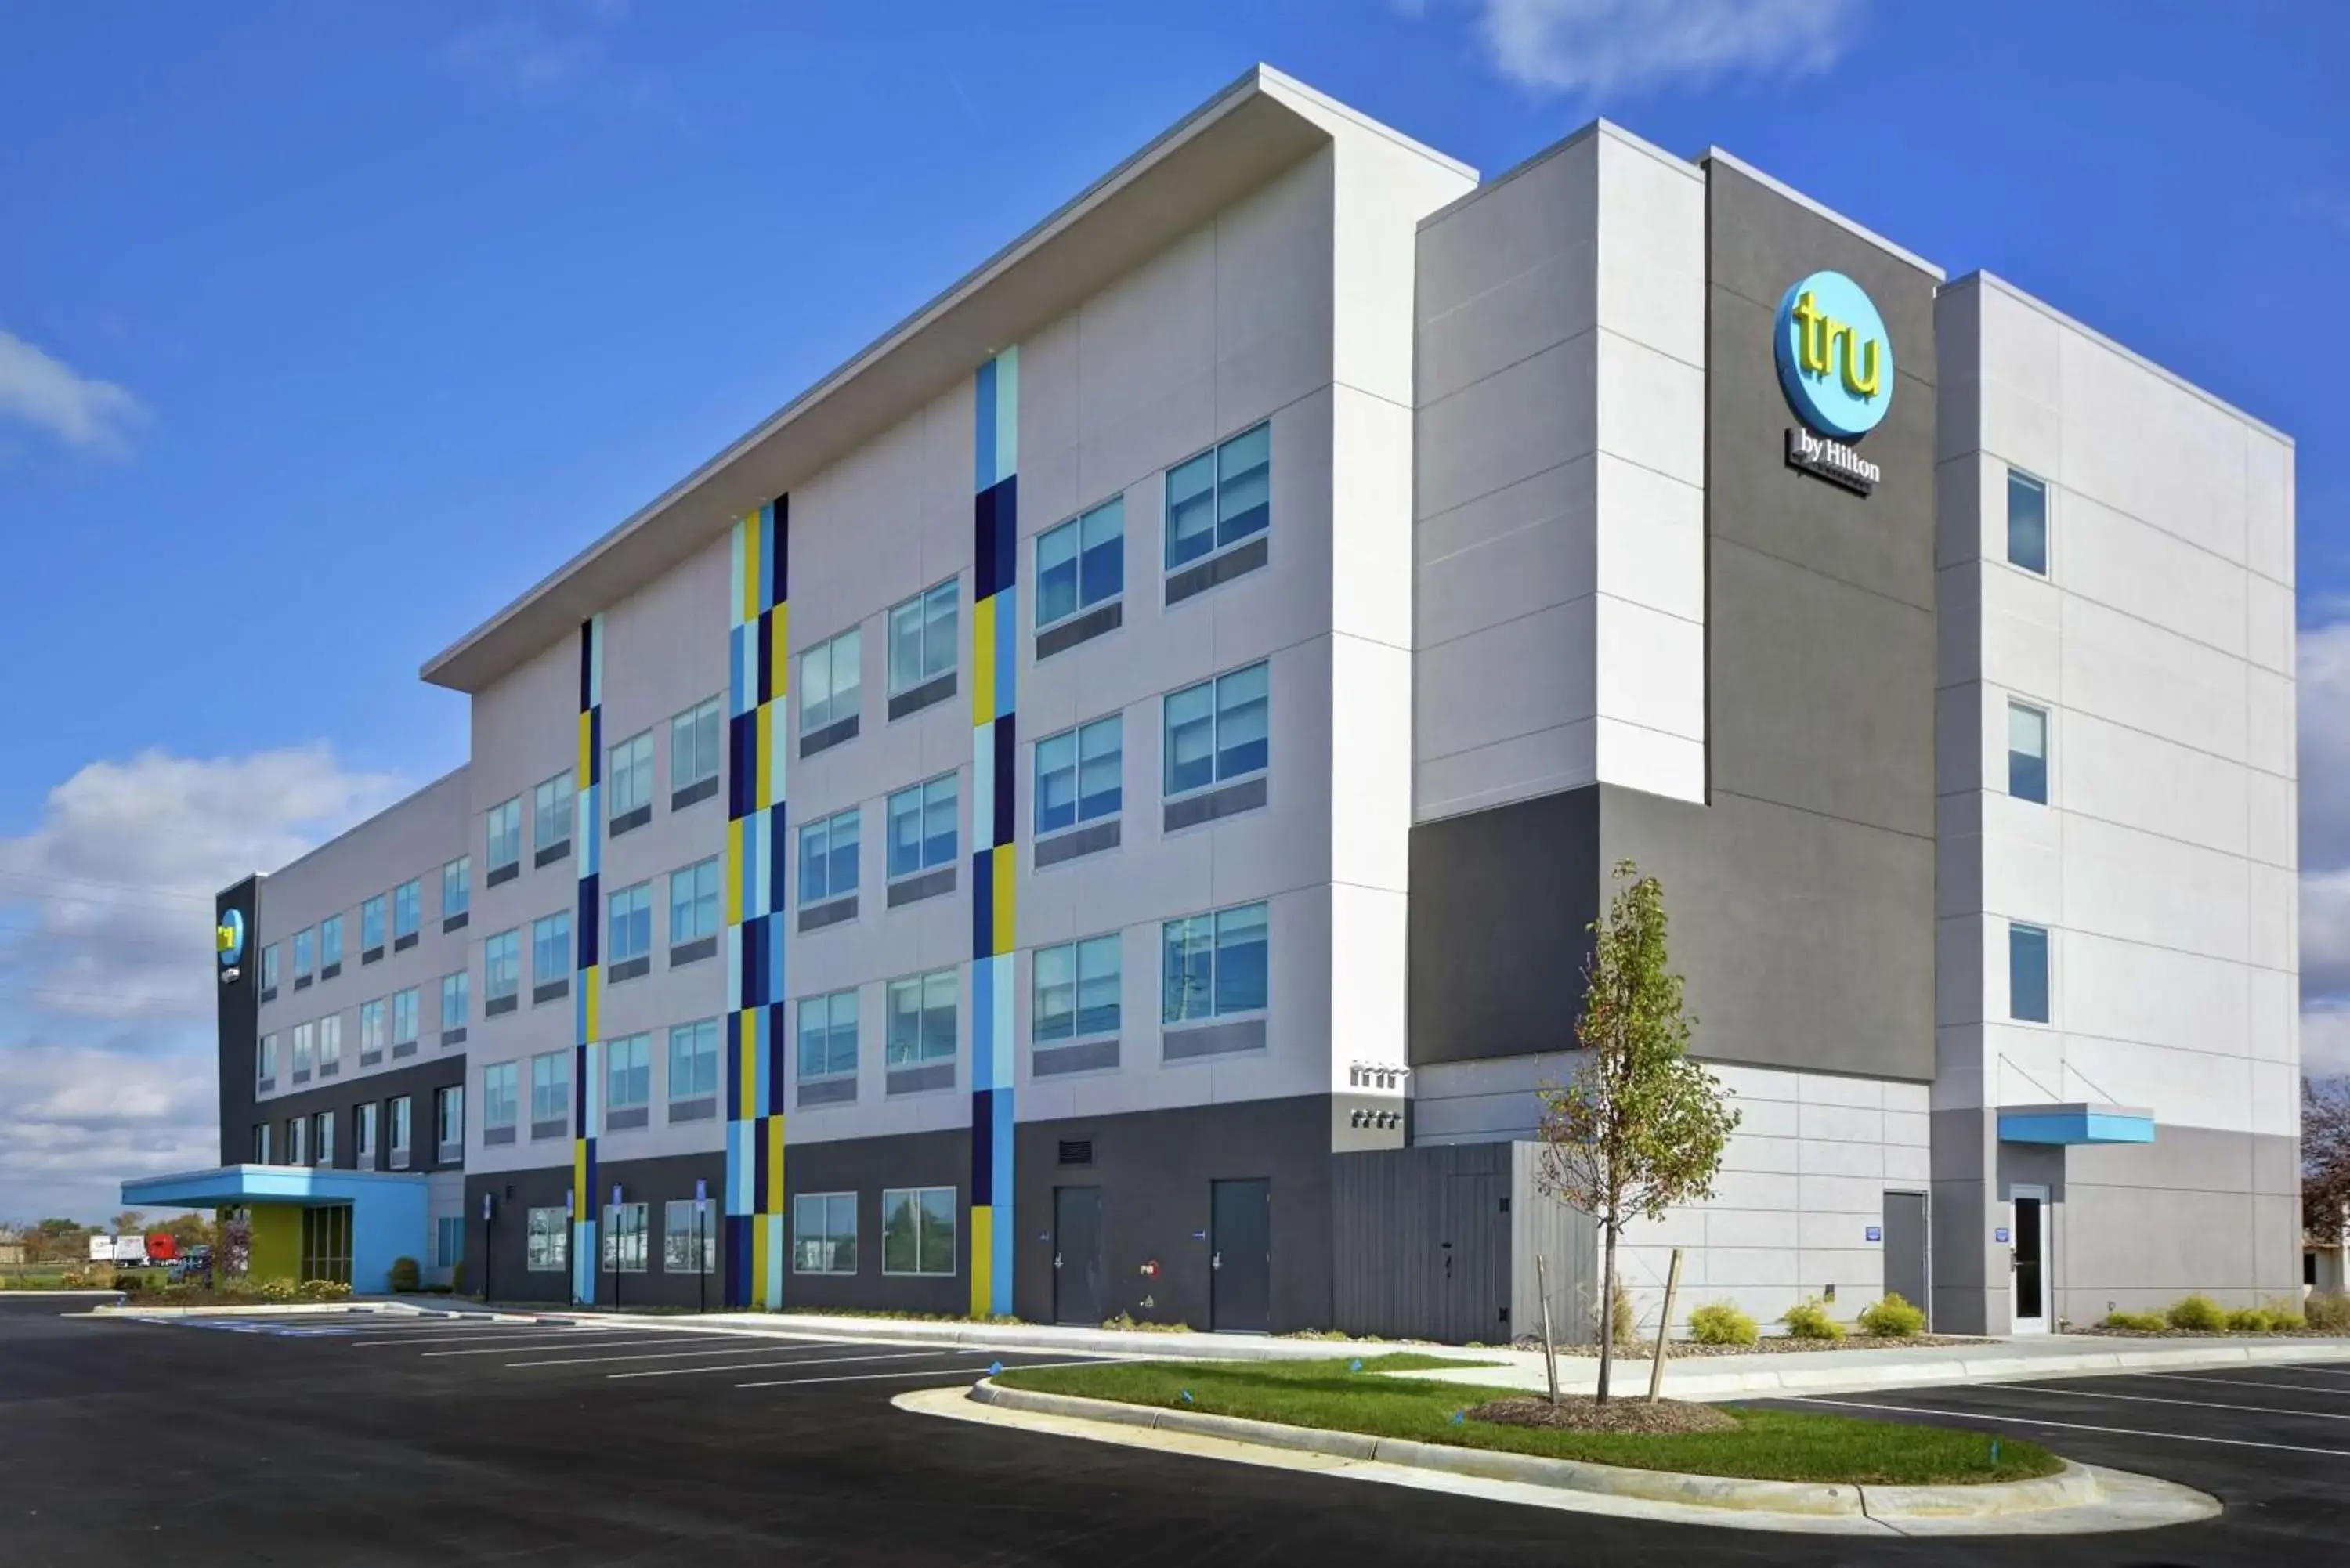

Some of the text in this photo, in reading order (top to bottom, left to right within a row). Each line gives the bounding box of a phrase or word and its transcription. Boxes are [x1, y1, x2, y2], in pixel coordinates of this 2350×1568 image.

[1792, 291, 1880, 397] tru
[1801, 427, 1880, 482] by Hilton
